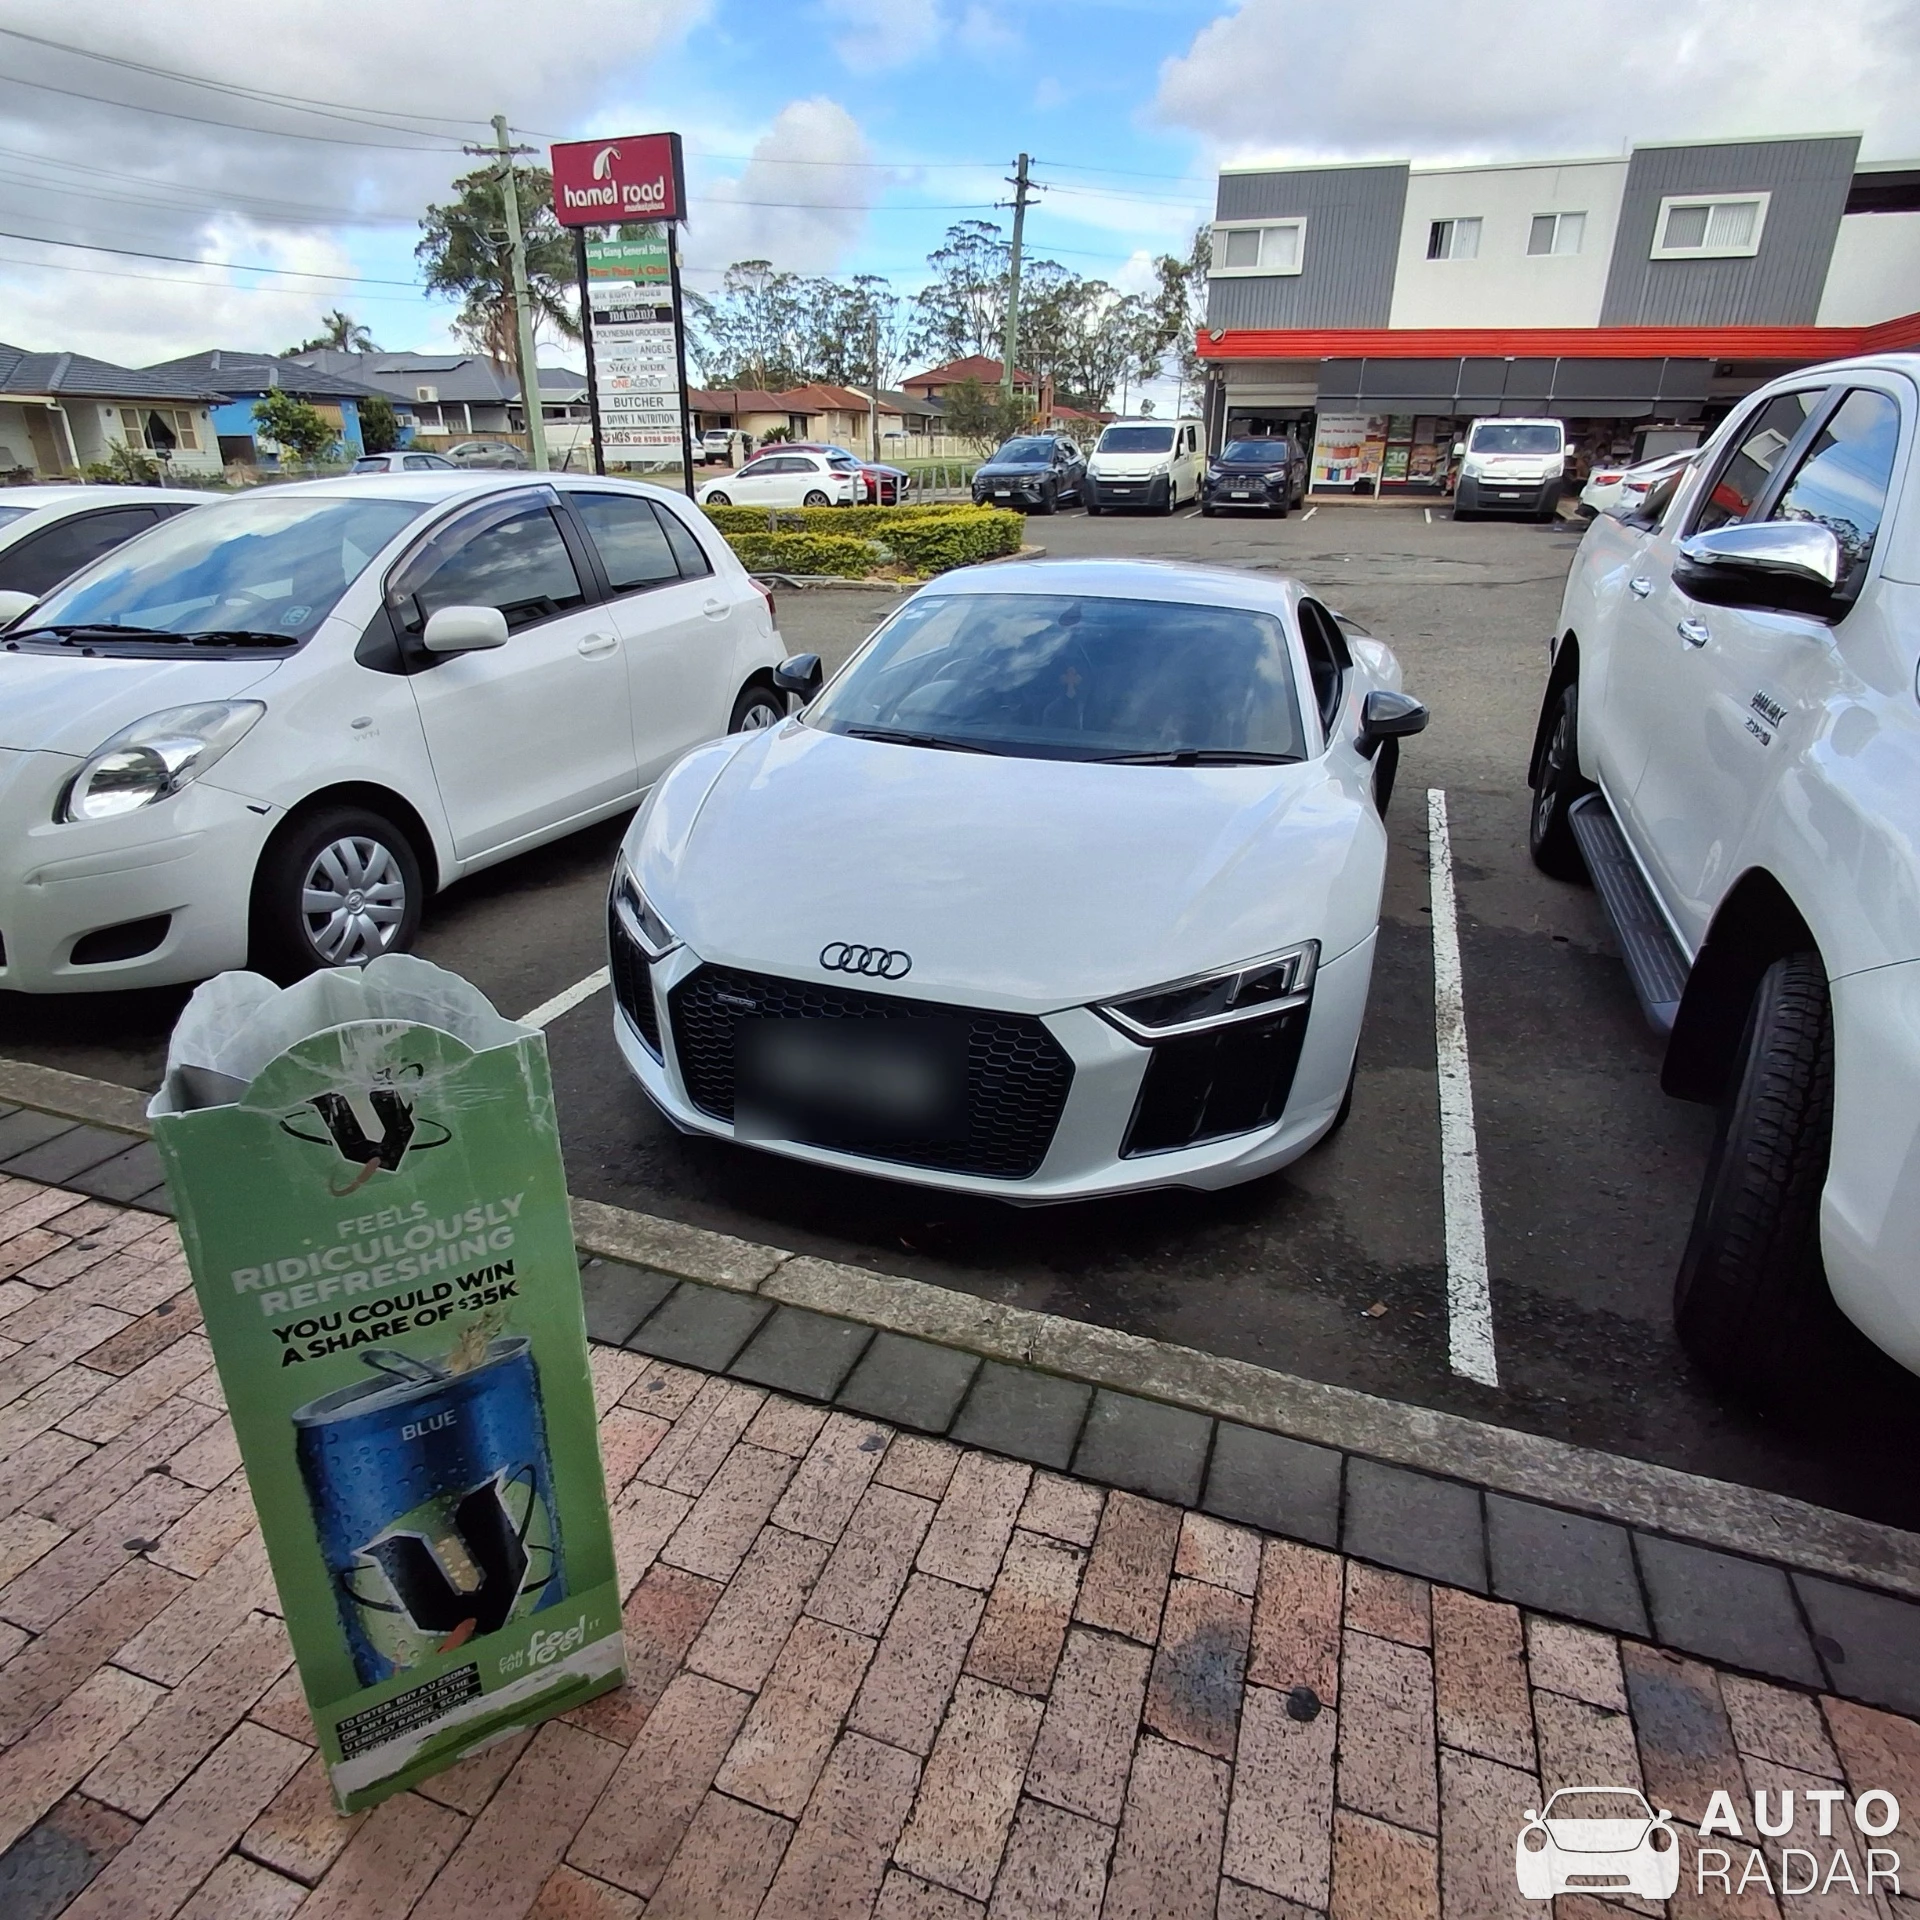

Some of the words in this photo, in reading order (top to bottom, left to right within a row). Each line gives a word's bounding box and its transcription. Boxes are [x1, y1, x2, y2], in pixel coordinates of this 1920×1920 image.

[564, 180, 618, 208] hamel
[622, 176, 665, 203] road
[586, 247, 602, 260] Long
[622, 244, 648, 256] General
[649, 244, 667, 254] Store
[596, 328, 634, 338] POLYNESIAN
[635, 328, 672, 336] GROCERIES
[640, 344, 672, 354] ANGELS
[607, 414, 629, 424] DIVINE
[637, 413, 675, 424] NUTRITION
[614, 396, 664, 408] BUTCHER
[337, 1200, 428, 1239] FEELS
[230, 1192, 524, 1294] RIDICULOUSLY
[259, 1226, 515, 1316] REFRESHING
[272, 1312, 342, 1345] YOU
[348, 1282, 453, 1324] COULD
[456, 1258, 516, 1292] WIN
[281, 1348, 306, 1368] A
[306, 1316, 411, 1359] SHARE
[413, 1301, 455, 1327] OF
[457, 1280, 520, 1312] $35K
[402, 1409, 458, 1441] BLUE
[527, 1614, 586, 1666] feel
[500, 1649, 524, 1667] CAN
[500, 1658, 523, 1674] YOU
[340, 1720, 355, 1731] TO
[396, 1691, 417, 1705] BUY
[420, 1687, 428, 1695] A
[438, 1666, 474, 1687] 250ML
[342, 1730, 358, 1742] OR
[361, 1719, 384, 1733] ANY
[385, 1695, 434, 1722] PRODUCT
[436, 1686, 448, 1698] IN
[450, 1678, 470, 1692] THE
[354, 1724, 396, 1747] ENERGY
[439, 1690, 468, 1707] SCAN
